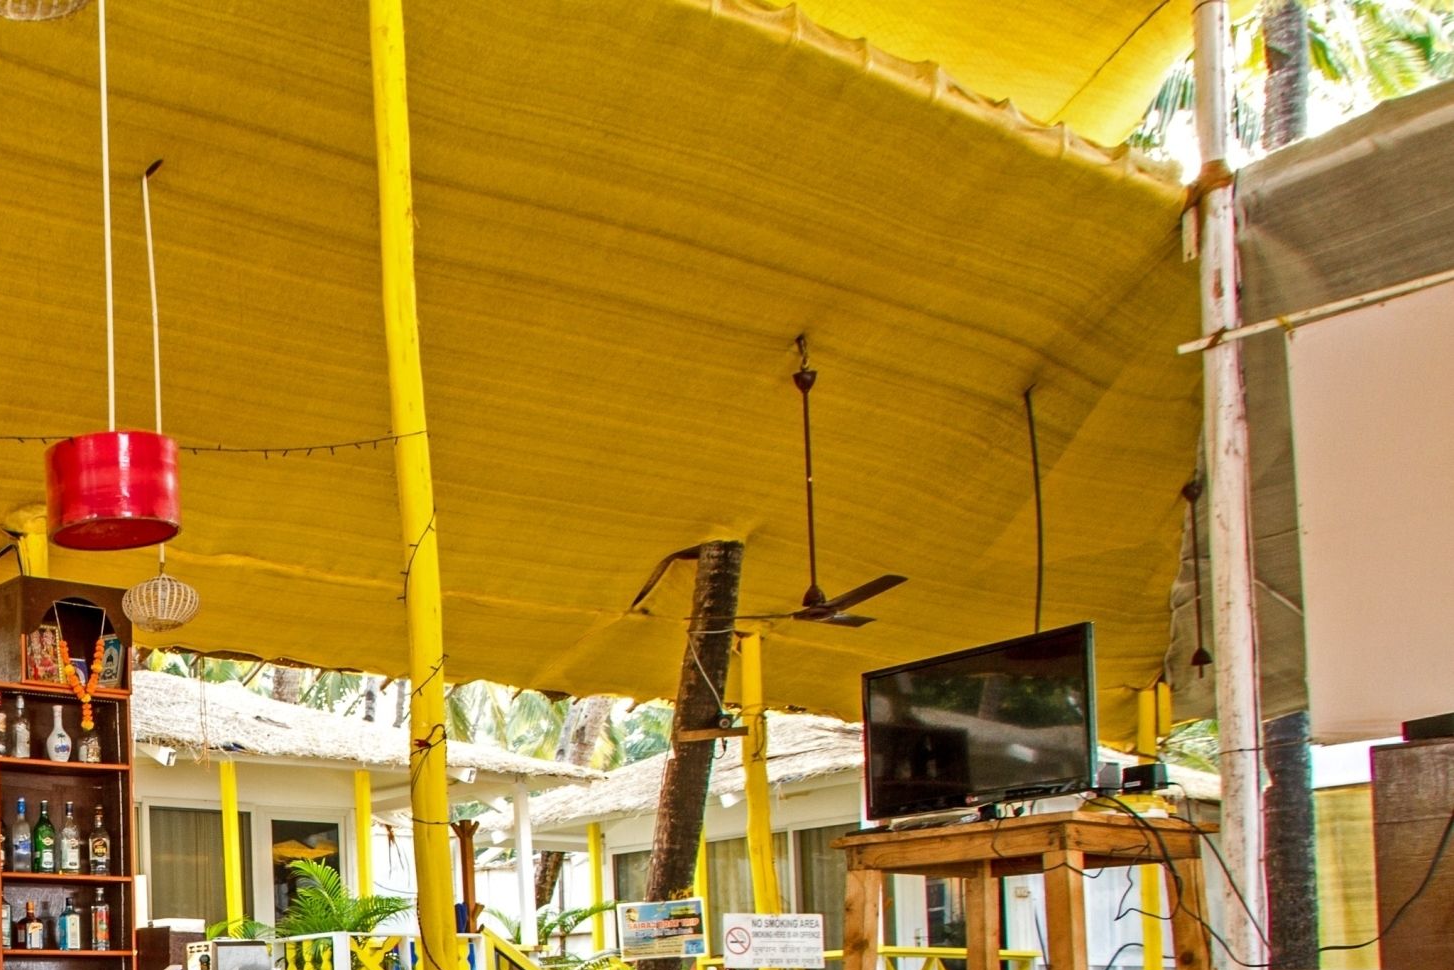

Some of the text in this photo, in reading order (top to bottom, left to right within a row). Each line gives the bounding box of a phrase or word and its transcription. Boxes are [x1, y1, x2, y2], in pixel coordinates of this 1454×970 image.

[751, 919, 820, 929] NO SMOKING AREA
